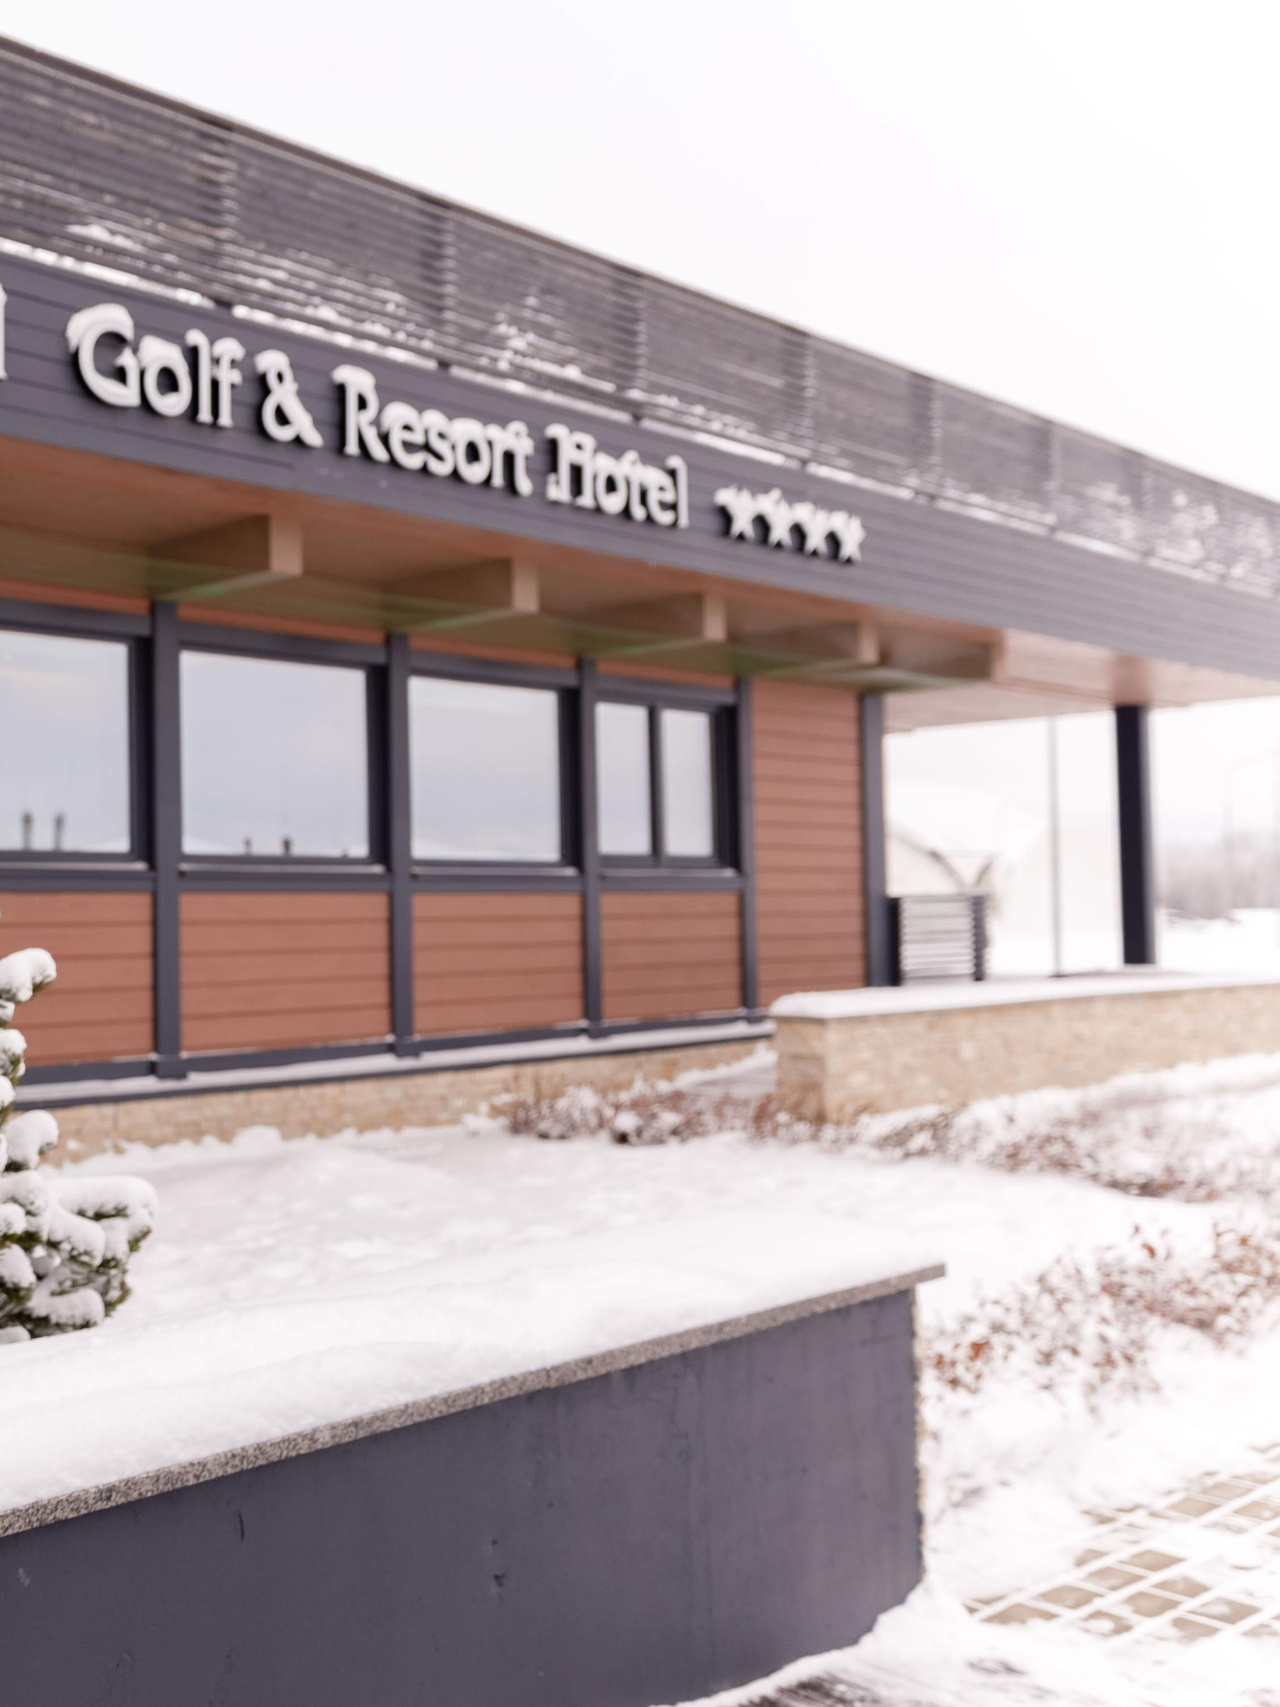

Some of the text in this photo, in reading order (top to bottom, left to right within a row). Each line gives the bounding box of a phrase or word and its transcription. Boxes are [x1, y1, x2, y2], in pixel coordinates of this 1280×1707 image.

[66, 303, 245, 428] Golf
[254, 350, 324, 448] &
[331, 364, 535, 497] Resort
[545, 423, 689, 528] Hotel
